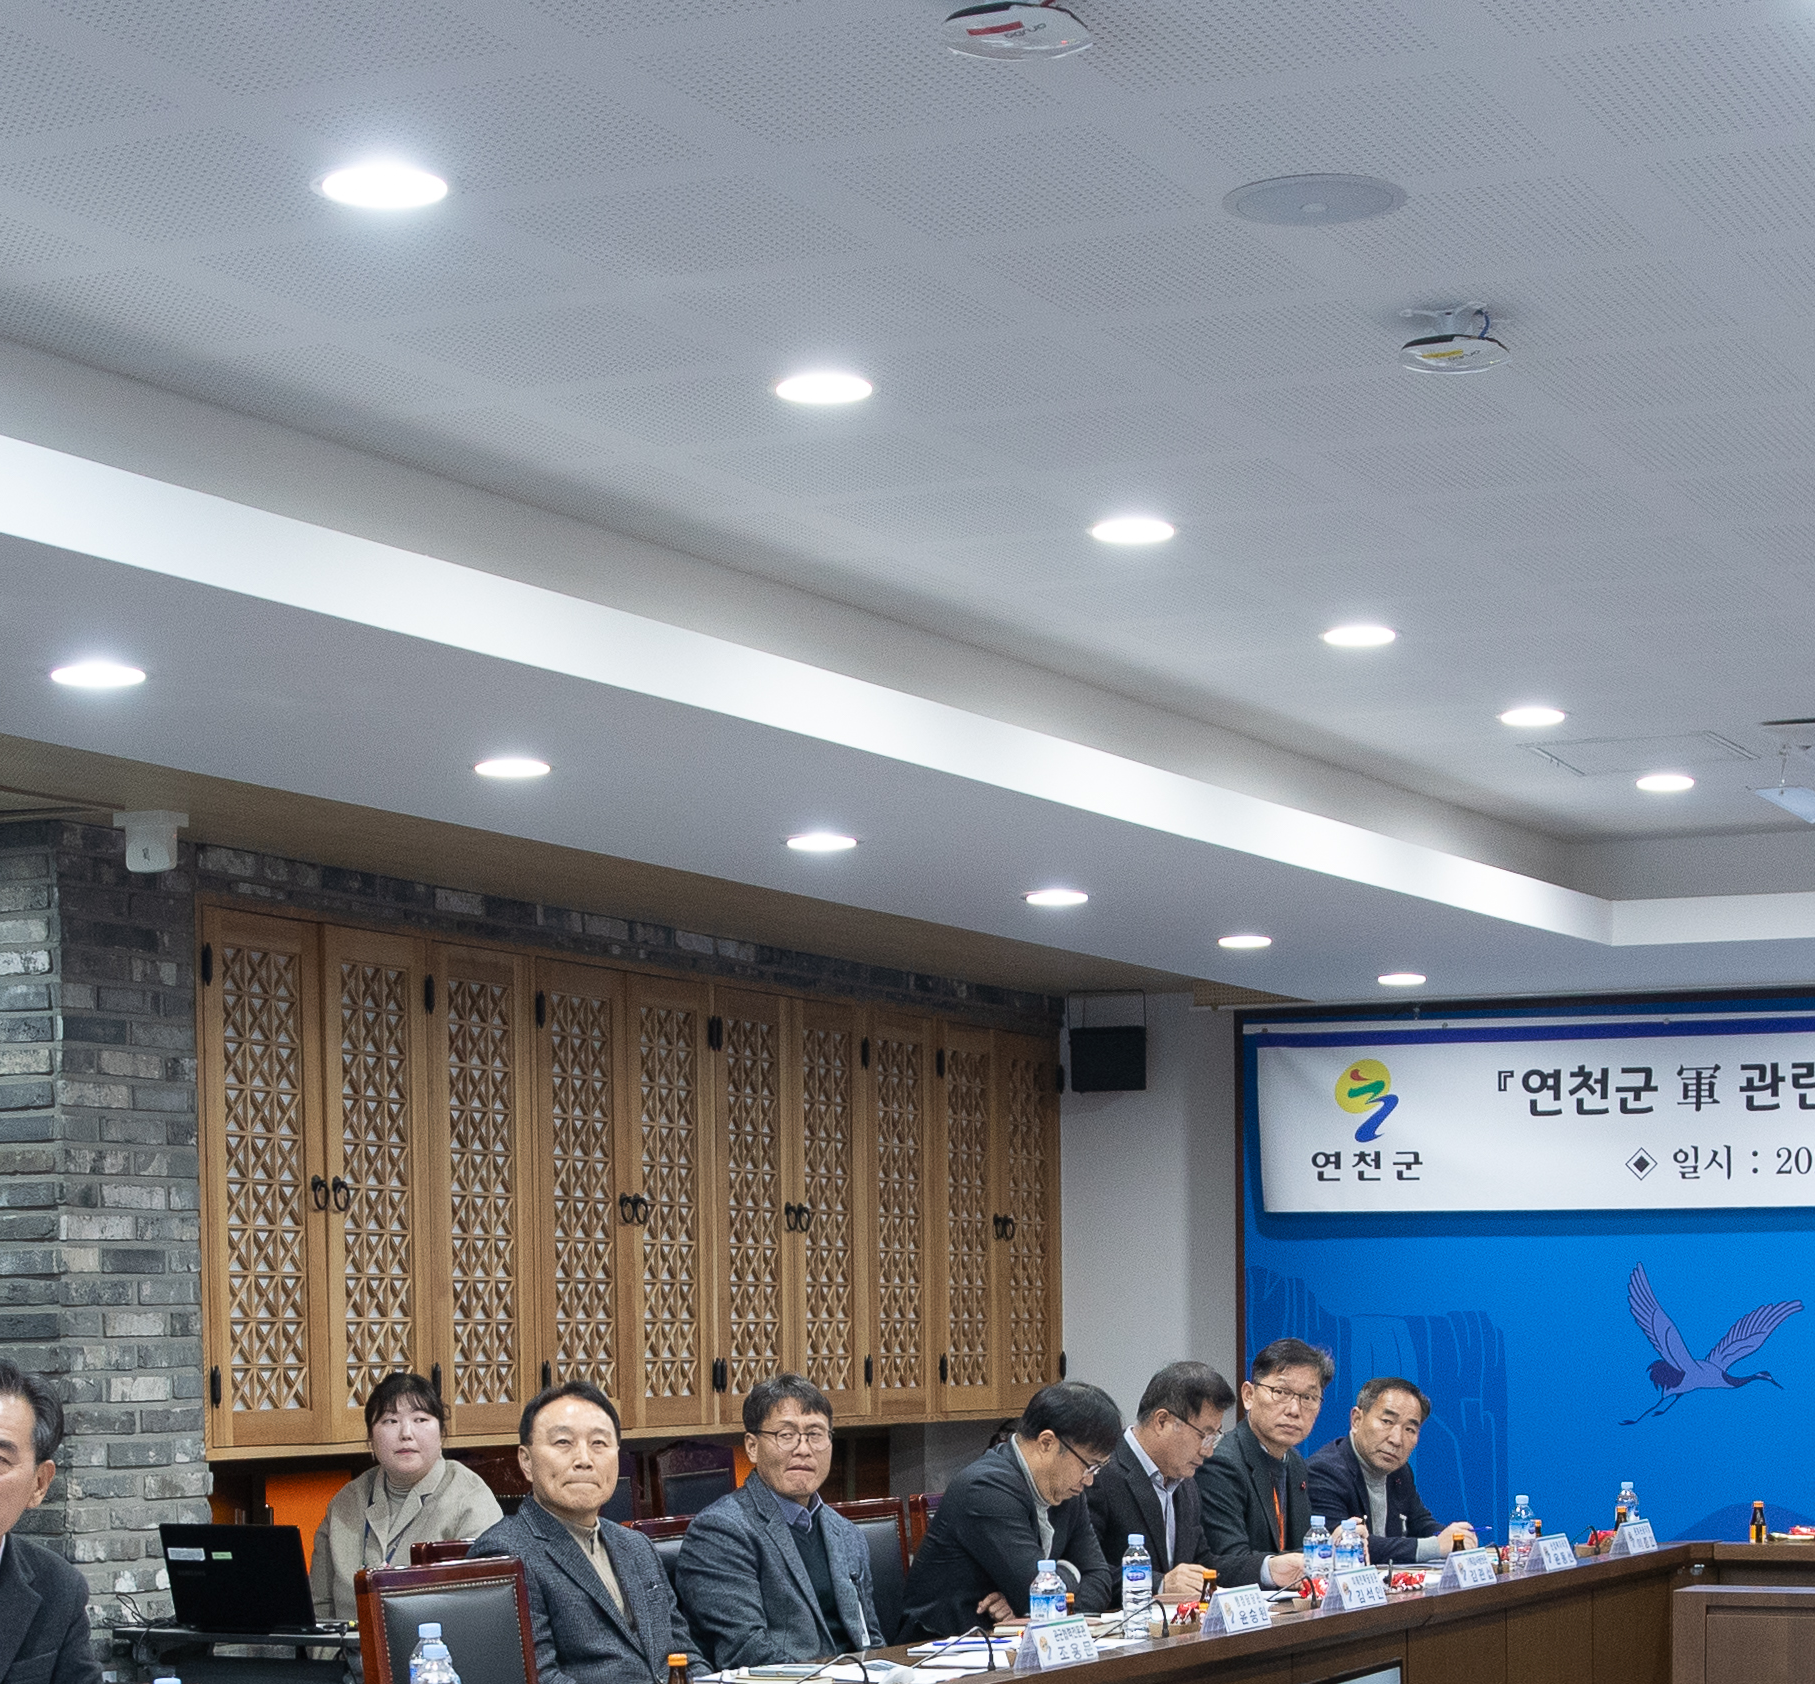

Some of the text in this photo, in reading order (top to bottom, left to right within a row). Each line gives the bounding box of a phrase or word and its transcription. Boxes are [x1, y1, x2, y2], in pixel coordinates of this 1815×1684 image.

[1497, 1063, 1659, 1117] 『연천군
[1676, 1063, 1722, 1112] 軍
[1310, 1150, 1423, 1182] 연천군
[1672, 1144, 1732, 1180] 일시
